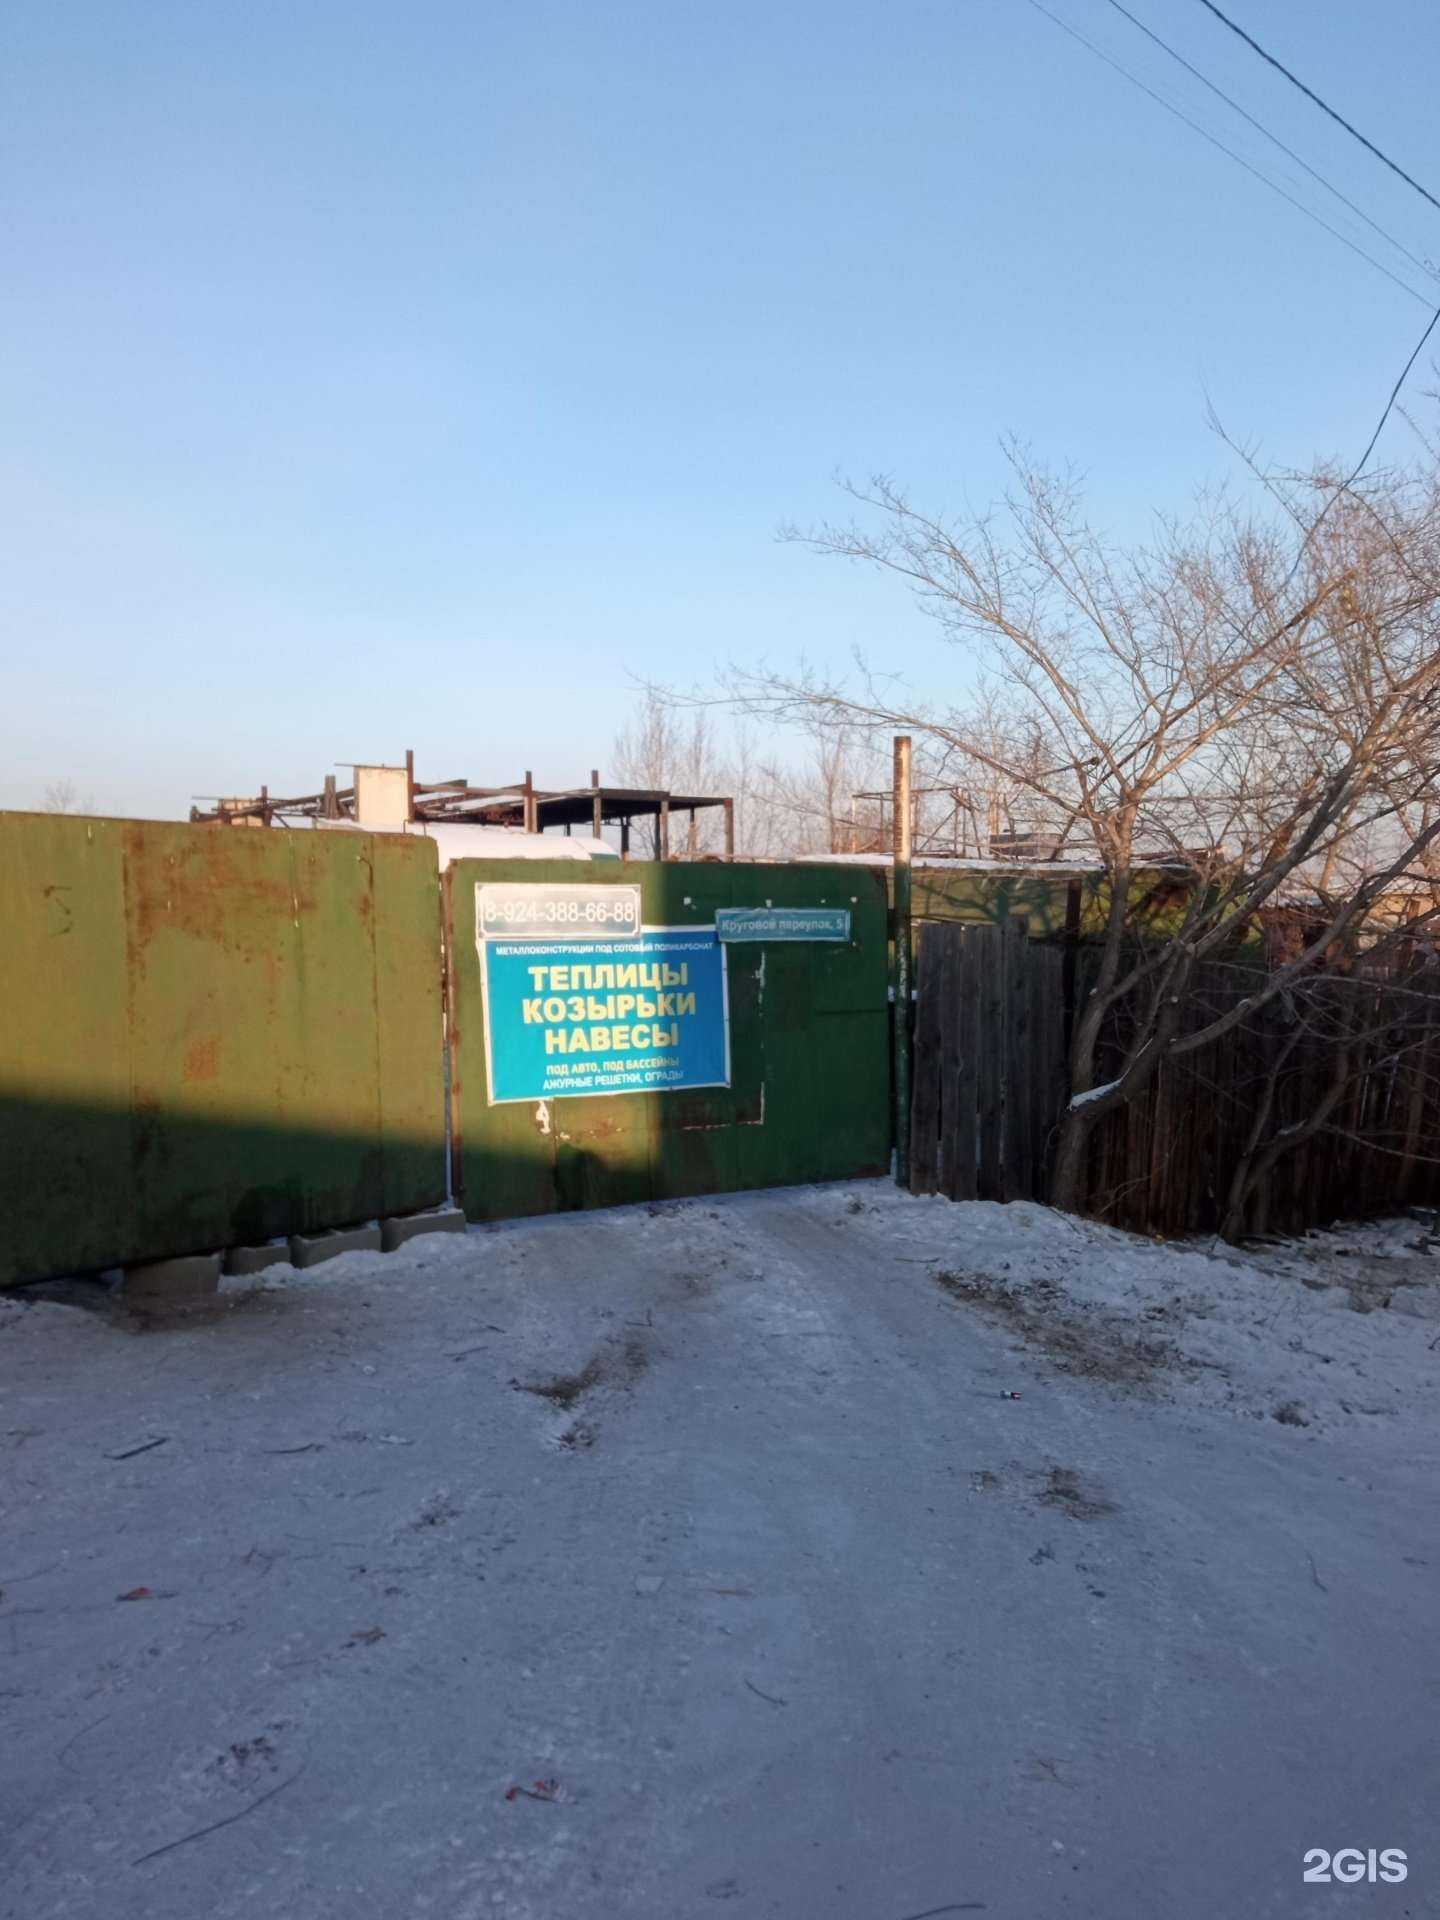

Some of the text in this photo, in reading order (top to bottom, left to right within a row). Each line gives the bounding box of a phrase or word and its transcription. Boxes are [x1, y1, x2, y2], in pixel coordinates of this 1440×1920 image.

[485, 901, 635, 922] 8-924-388-66-88
[722, 918, 776, 933] Круговой
[496, 942, 713, 955] МЕТАЛЛОКОНСТРУКЦИИ ПОД СОТОВЫЙ ПОЛИКАРБОНАТ
[528, 963, 688, 992] ТЕПЛИЦЫ
[522, 993, 696, 1024] КОЗЫРЬКИ
[545, 1023, 679, 1055] НАВЕСЫ
[546, 1056, 679, 1076] ПОД АВТО, ПОД БАССЕЙНЫ
[543, 1070, 684, 1090] АЖУРНЫЕ РЕШЕТКИ, ОГРАДЫ
